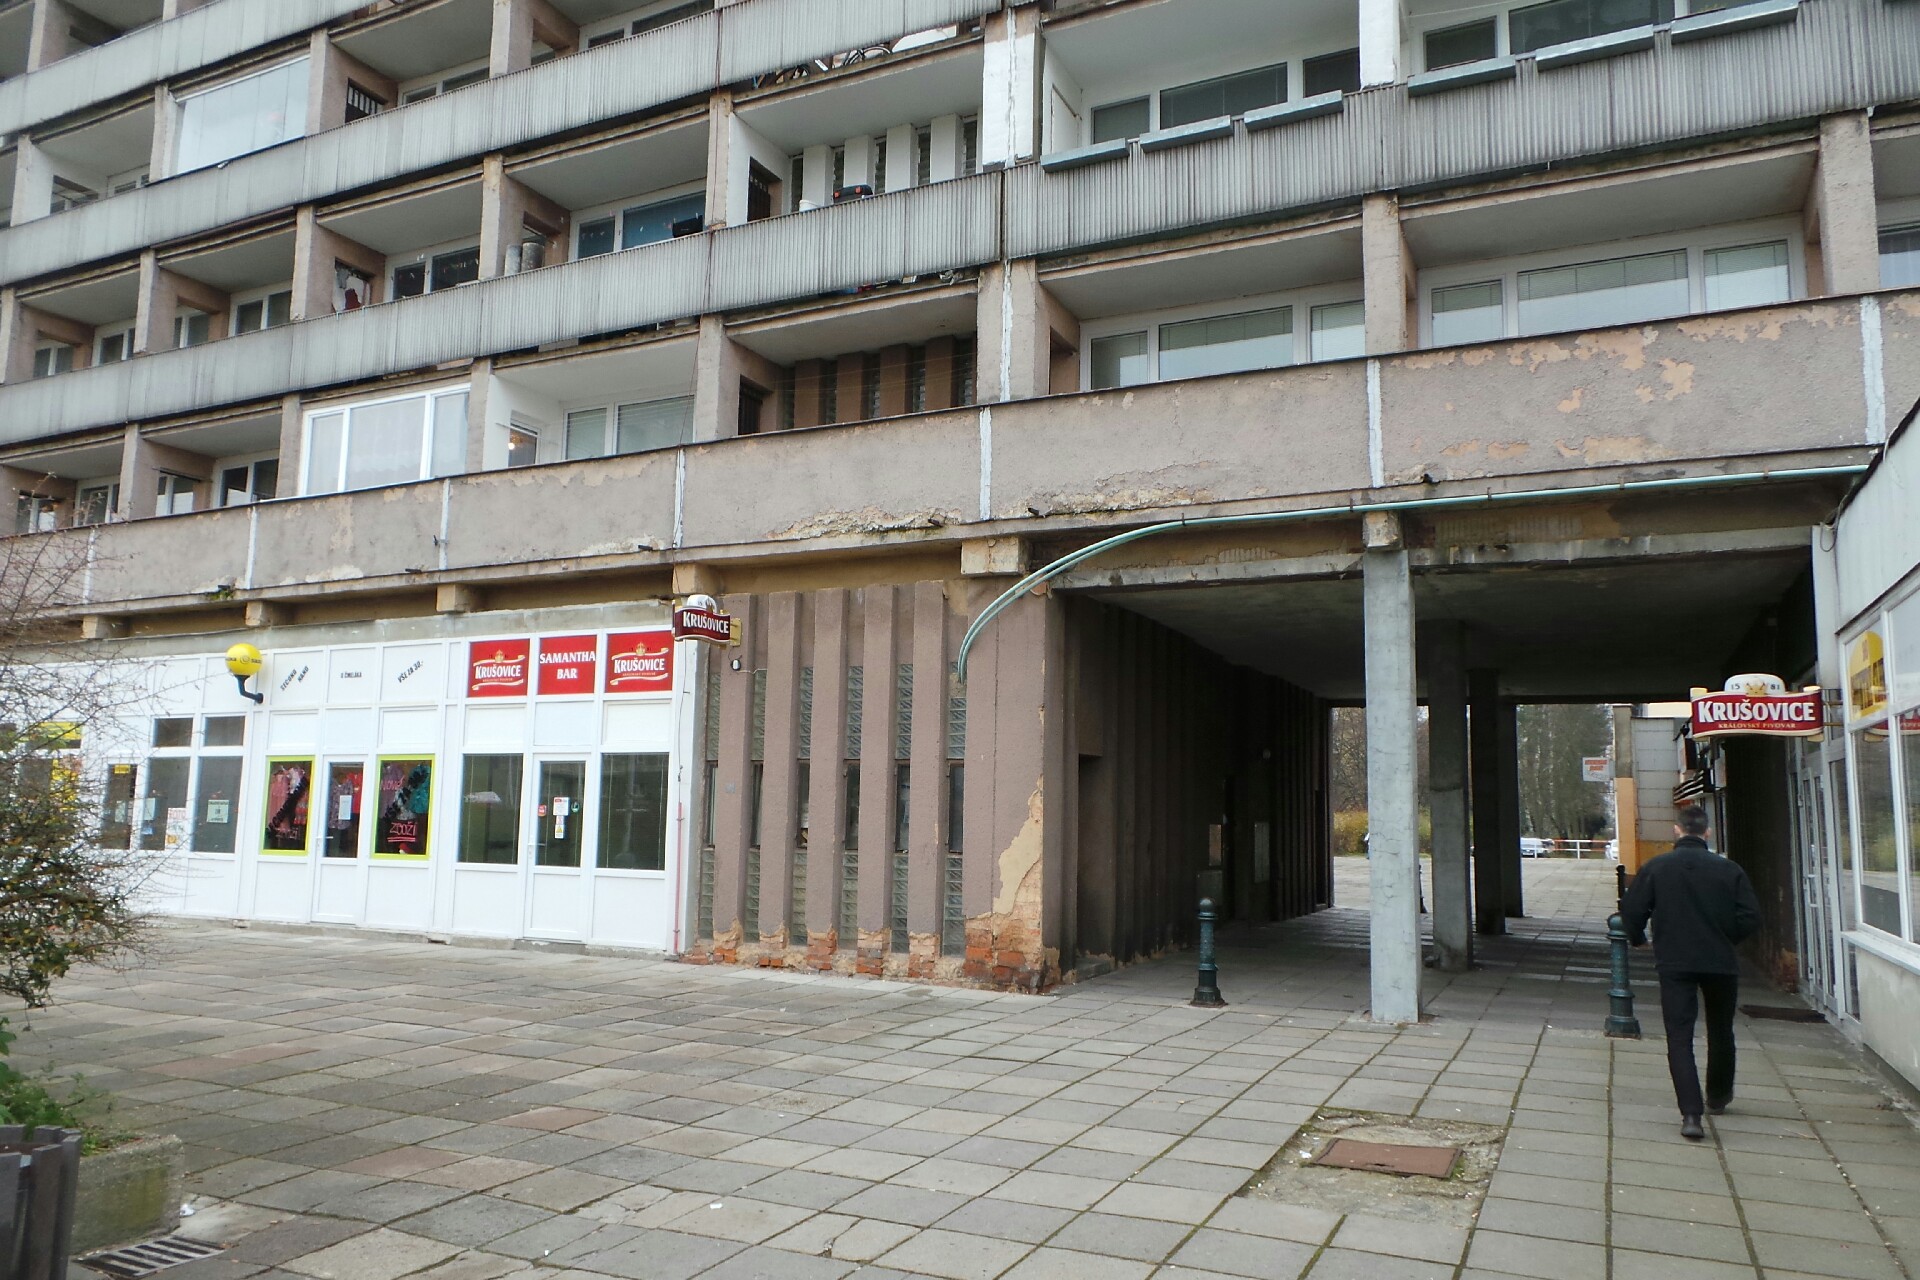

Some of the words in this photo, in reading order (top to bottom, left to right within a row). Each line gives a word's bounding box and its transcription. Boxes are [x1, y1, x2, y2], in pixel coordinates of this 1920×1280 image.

[682, 610, 730, 634] KRUŠOVICE
[539, 650, 597, 665] SAMANTHA
[613, 656, 666, 674] KRUŠOVICE
[474, 663, 522, 679] KRUŠOVICE
[556, 667, 579, 680] BAR
[1730, 682, 1741, 690] 15
[1770, 682, 1780, 691] 81
[1698, 698, 1816, 723] KRUŠOVICE
